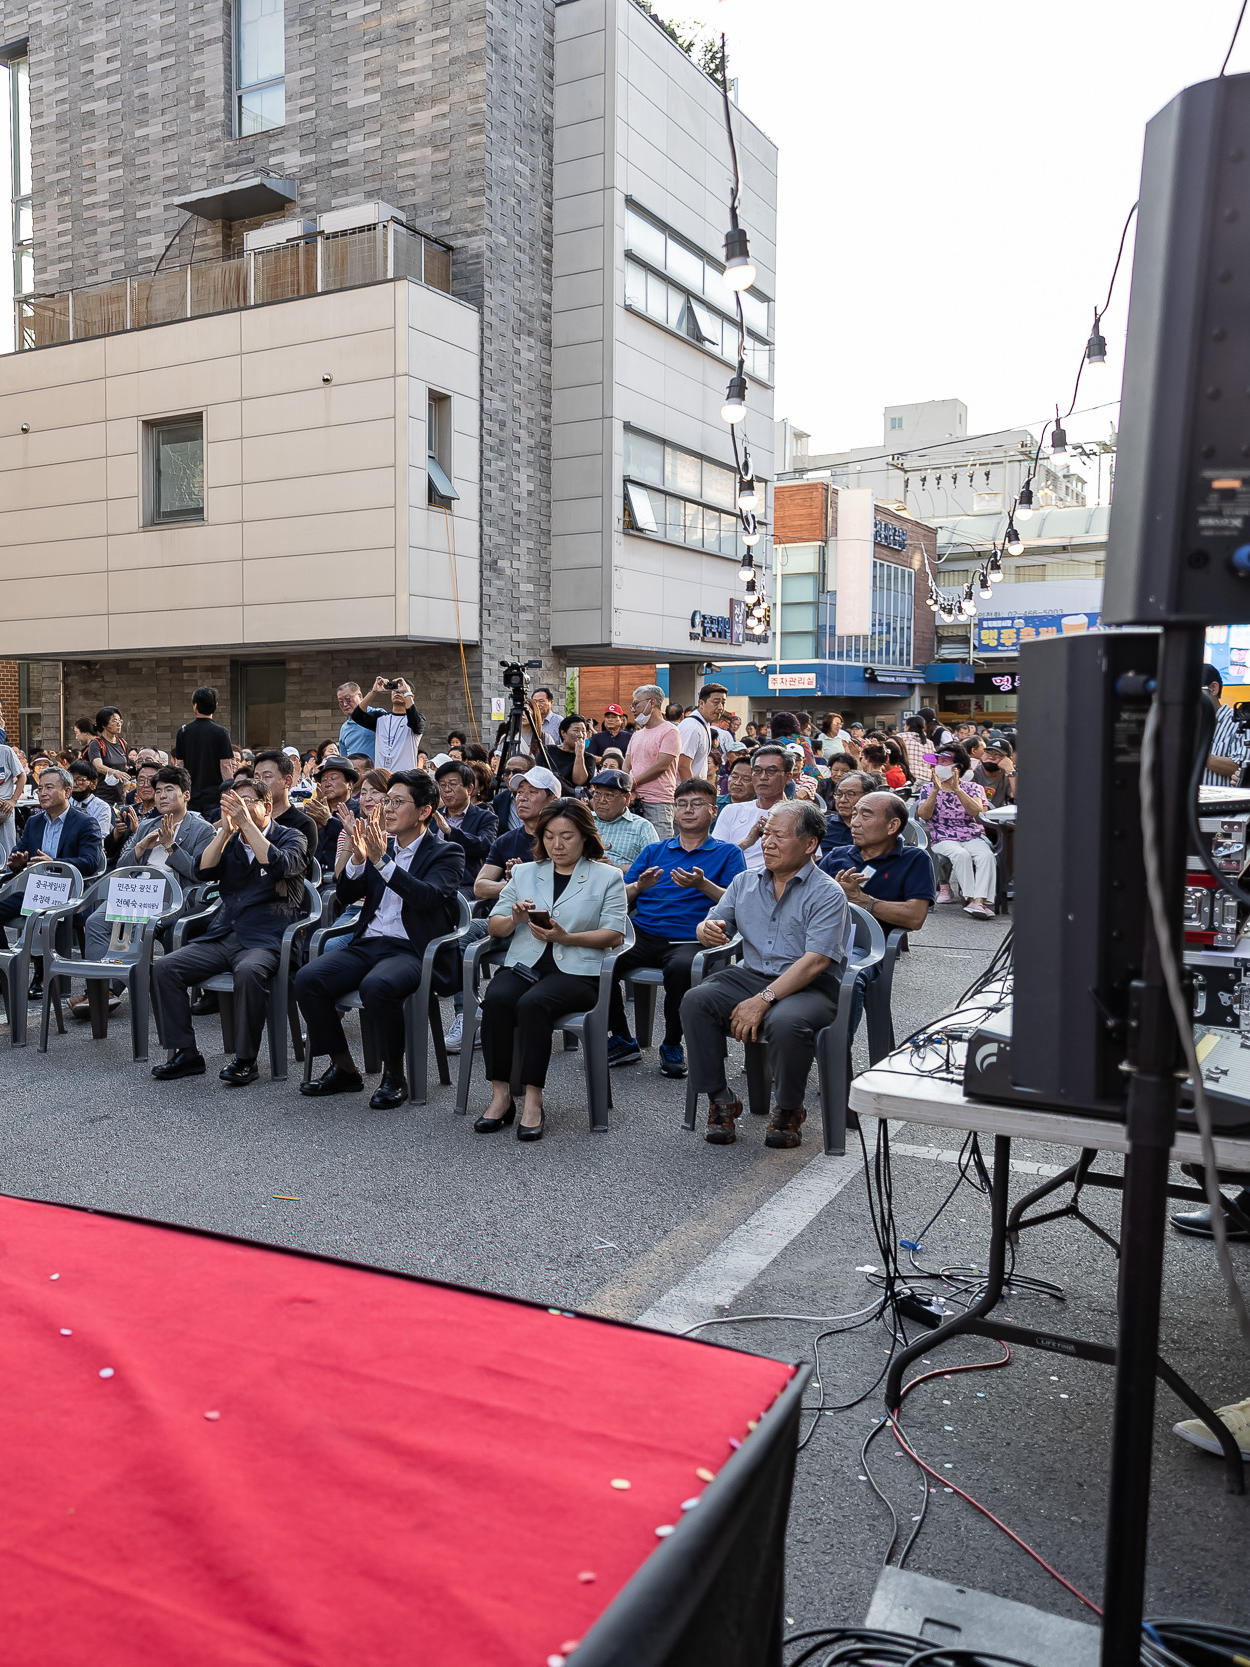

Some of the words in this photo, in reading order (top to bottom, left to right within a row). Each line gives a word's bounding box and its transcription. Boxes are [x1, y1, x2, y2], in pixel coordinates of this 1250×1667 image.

[770, 676, 815, 687] 주차관리실
[35, 879, 67, 892] 중곡제일시장
[117, 883, 137, 893] 민주당
